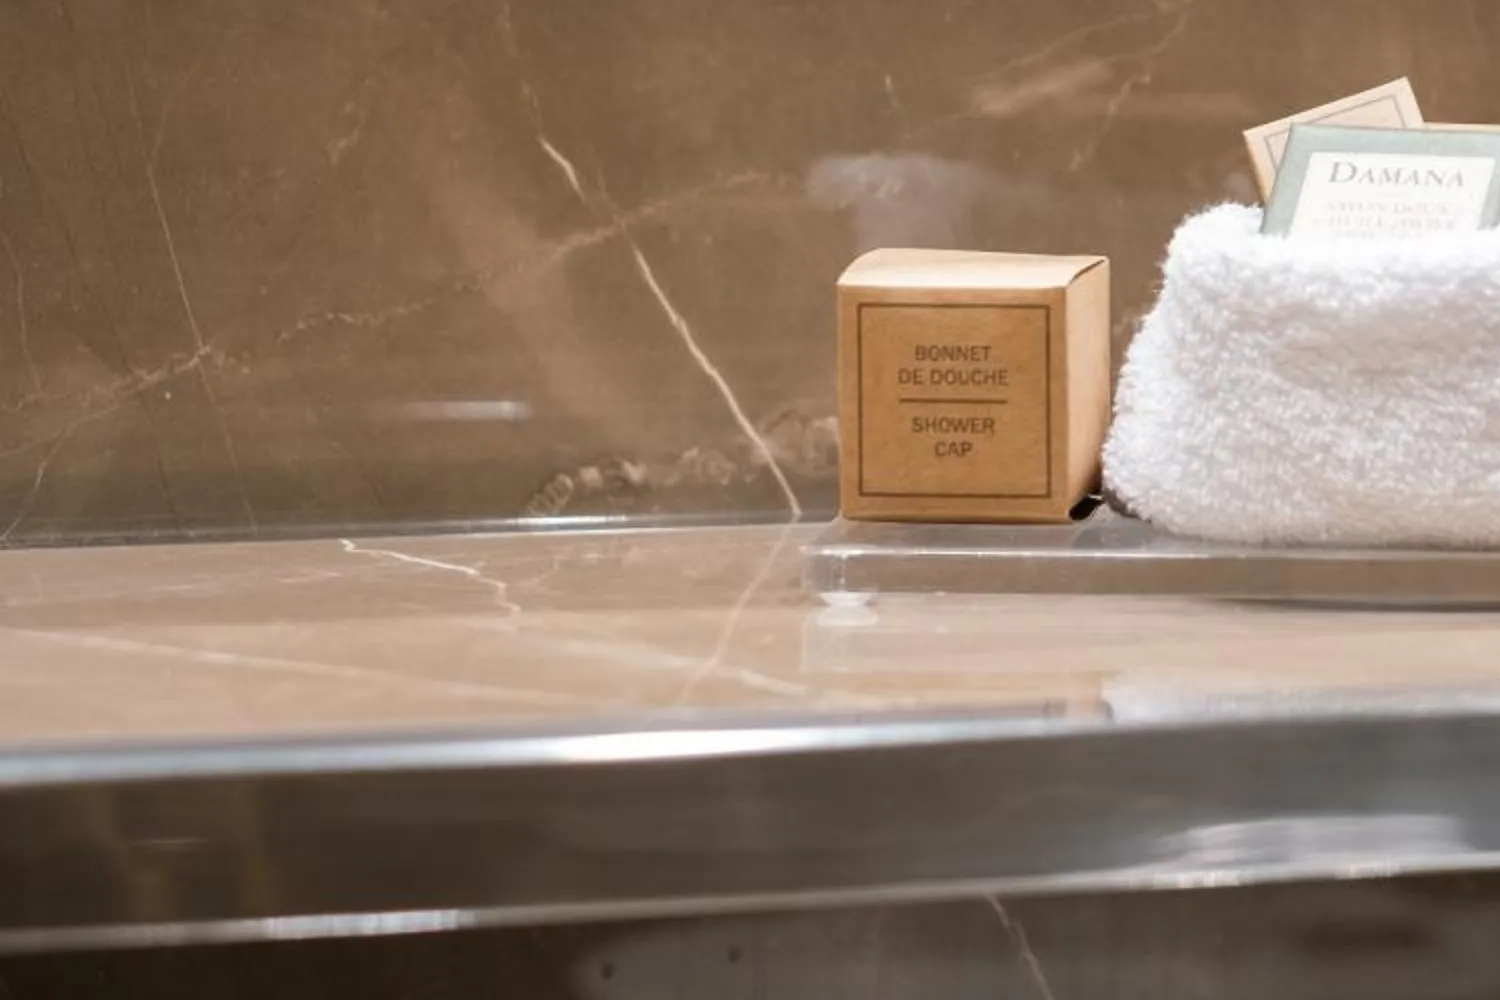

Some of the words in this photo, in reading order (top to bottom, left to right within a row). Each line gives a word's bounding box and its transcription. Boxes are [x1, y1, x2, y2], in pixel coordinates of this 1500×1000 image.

[1328, 160, 1464, 187] DAMANA
[914, 345, 991, 362] BONNET
[898, 370, 924, 386] DE
[930, 370, 1009, 386] DOUCHE
[911, 416, 995, 435] SHOWER
[934, 441, 974, 457] CAP
